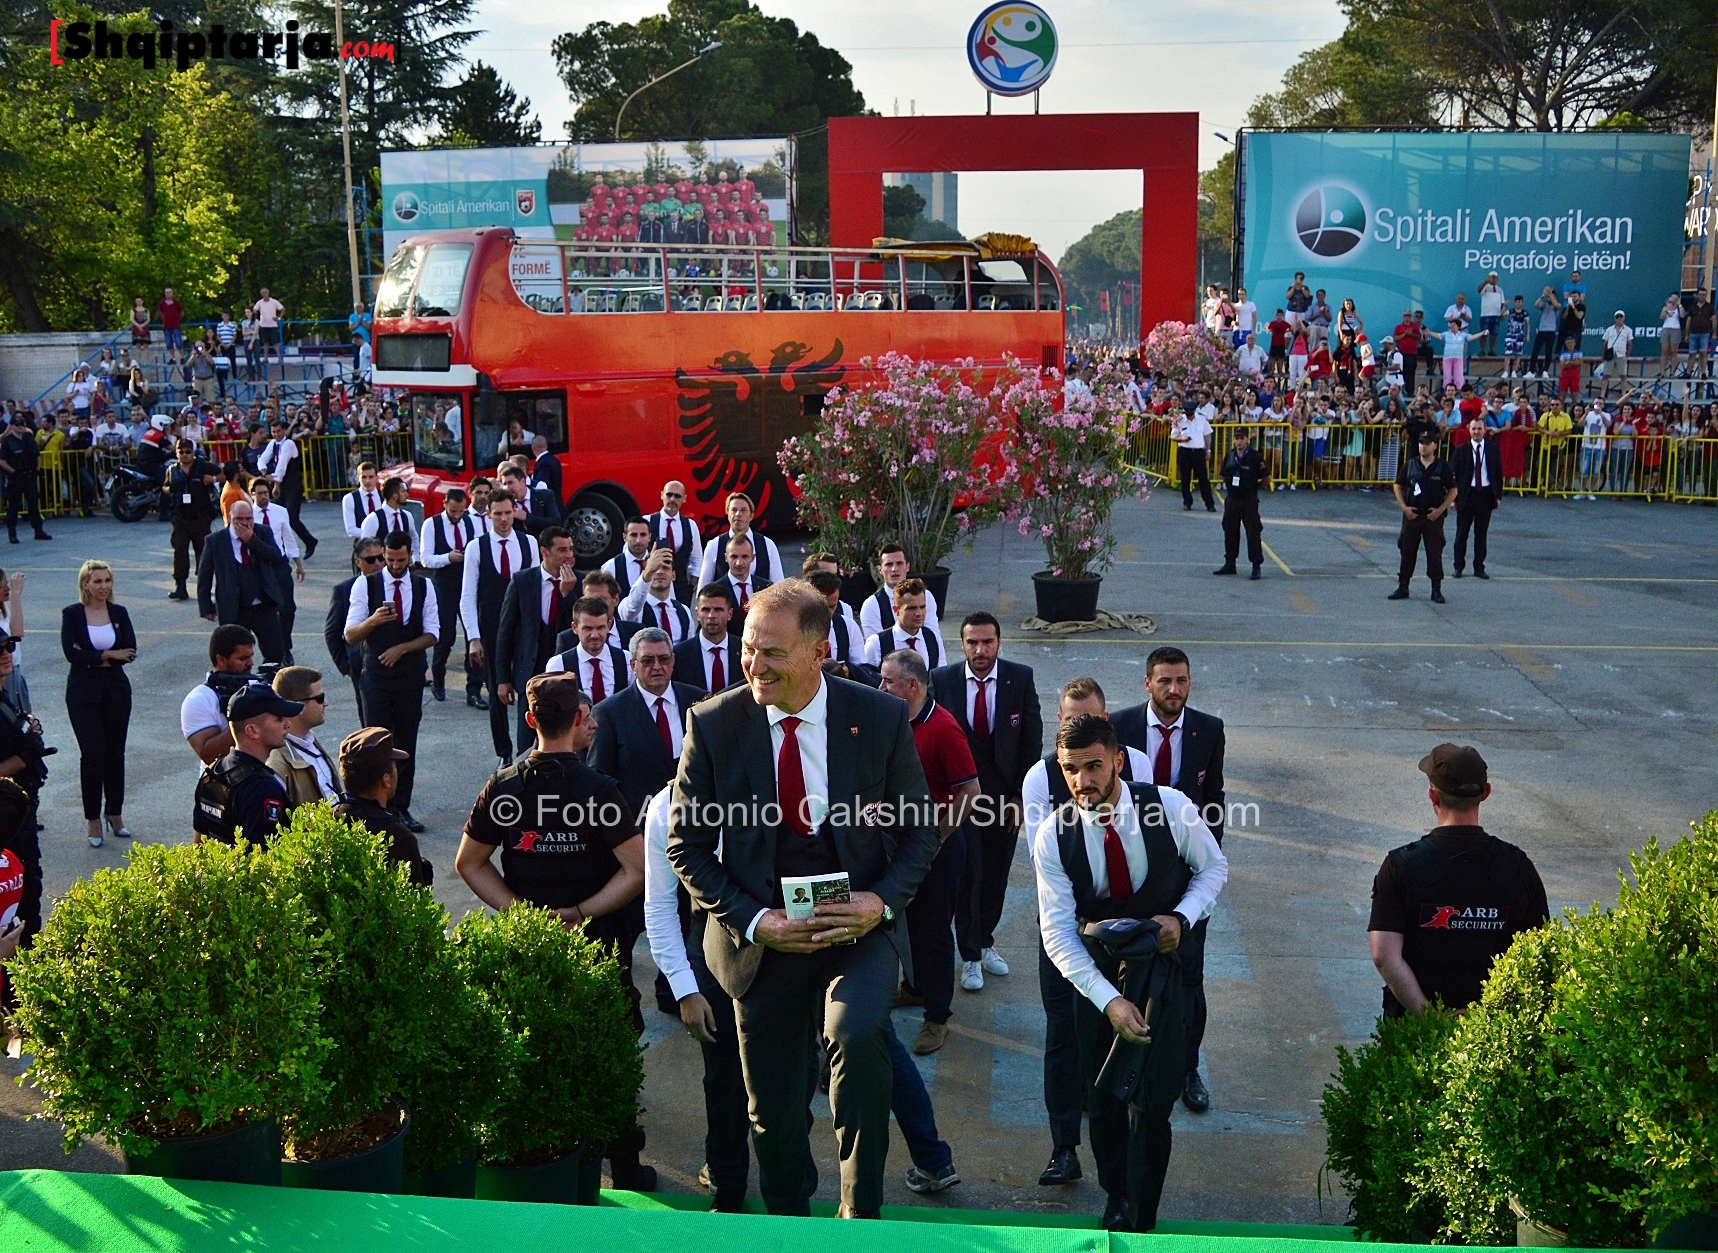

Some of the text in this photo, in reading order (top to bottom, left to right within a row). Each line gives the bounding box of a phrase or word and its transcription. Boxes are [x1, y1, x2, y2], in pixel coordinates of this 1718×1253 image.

[420, 199, 510, 216] Spitali Amerikan
[1373, 207, 1634, 250] Spitali Amerikan
[511, 260, 552, 275] FORMË
[1464, 249, 1631, 274] Përqafoje jetën!
[544, 832, 579, 843] ARB
[536, 843, 588, 853] SECURITY
[1460, 907, 1499, 919] ARB
[1450, 920, 1506, 930] SECURITY
